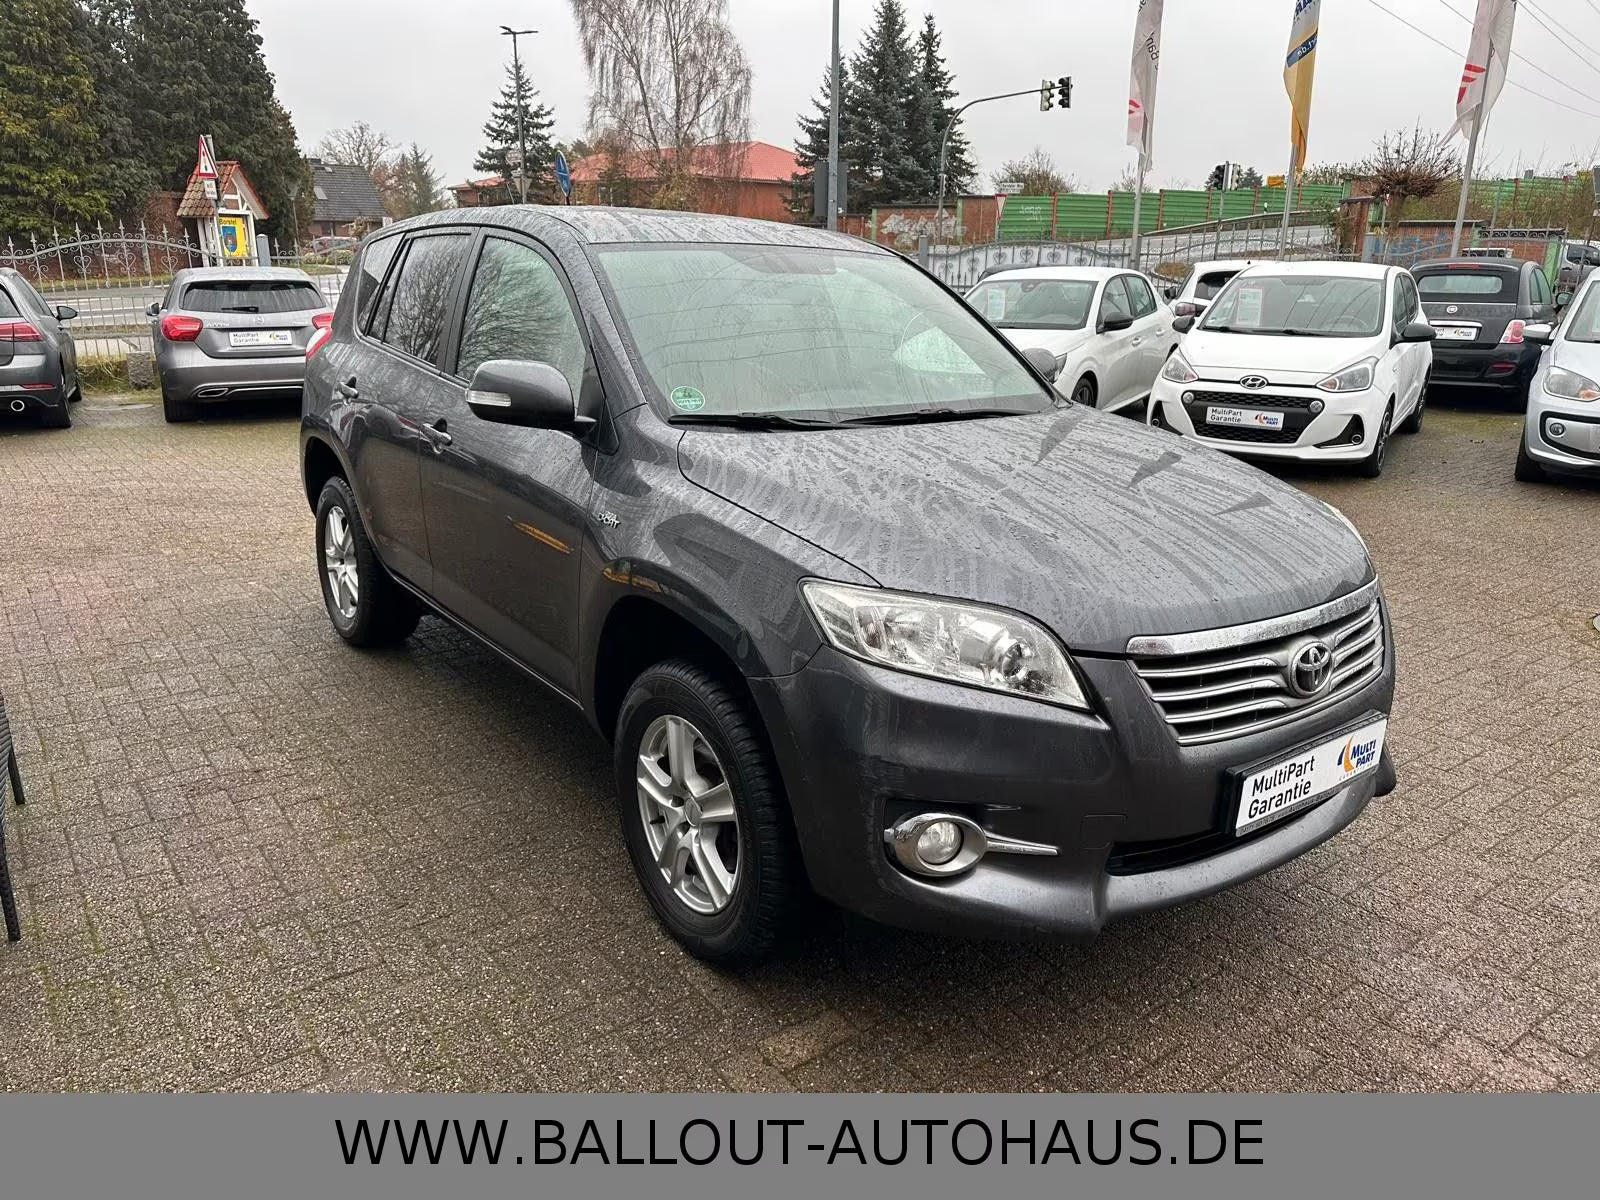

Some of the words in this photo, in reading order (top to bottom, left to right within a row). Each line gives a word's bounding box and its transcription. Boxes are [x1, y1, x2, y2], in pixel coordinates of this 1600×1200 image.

[1210, 414, 1242, 423] Garantie
[1211, 408, 1242, 417] MultiPart
[1355, 751, 1375, 768] PART
[1252, 755, 1315, 796] MultiPart
[1248, 779, 1312, 819] Garantie
